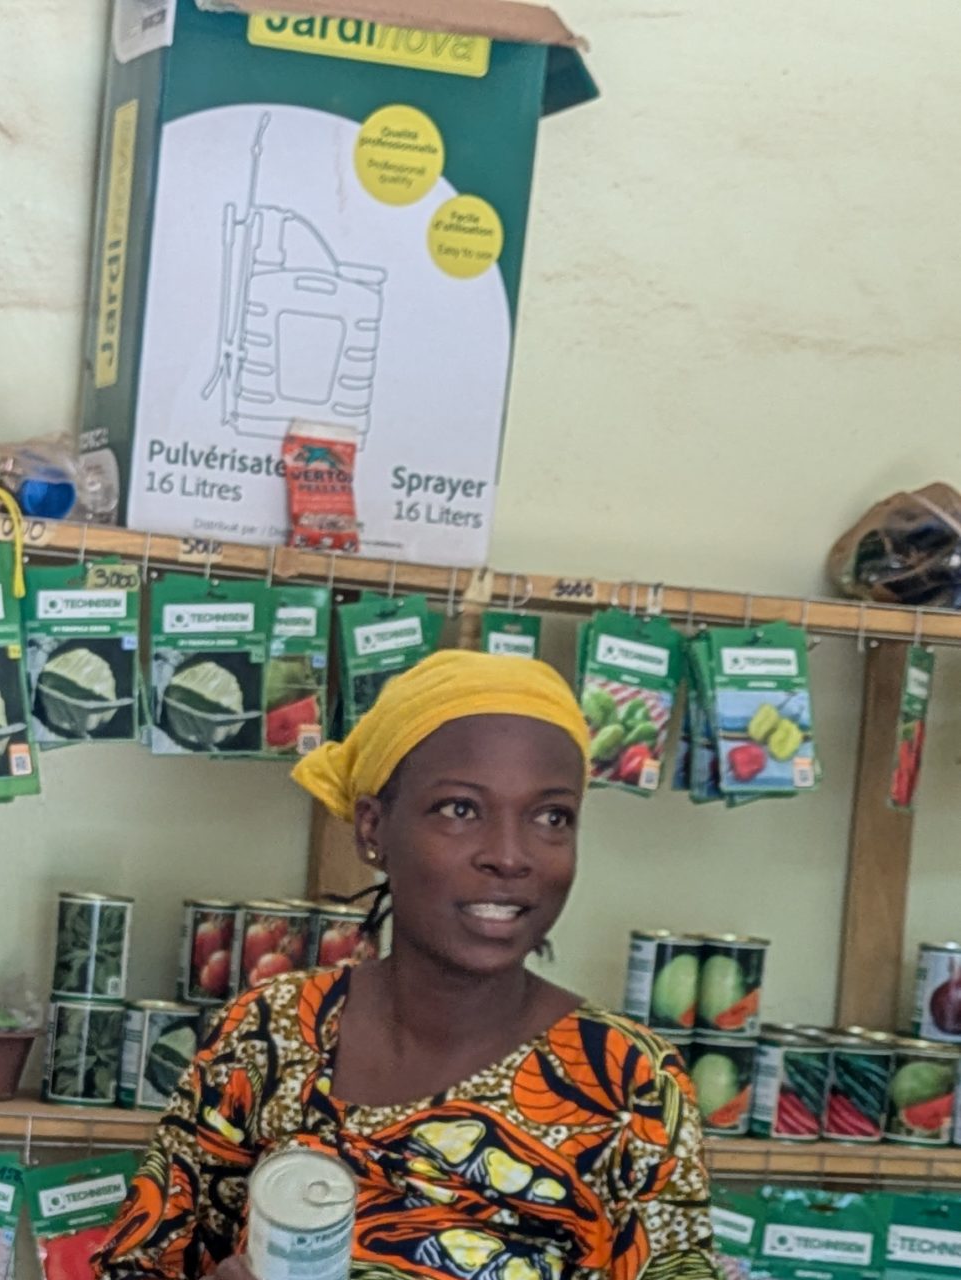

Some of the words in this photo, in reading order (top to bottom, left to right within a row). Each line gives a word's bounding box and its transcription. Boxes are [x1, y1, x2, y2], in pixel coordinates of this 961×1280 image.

[149, 440, 286, 477] Pulvérisate
[145, 471, 174, 494] 16
[180, 474, 242, 502] Litres
[391, 466, 487, 502] Sprayer
[394, 500, 420, 521] 16
[426, 503, 482, 529] Liters
[94, 567, 138, 588] 3000
[64, 598, 122, 610] TECHNISEM
[190, 612, 249, 624] TECHNISEM
[66, 1184, 122, 1204] TECHNISEM
[794, 1235, 866, 1254] TECHNISEM
